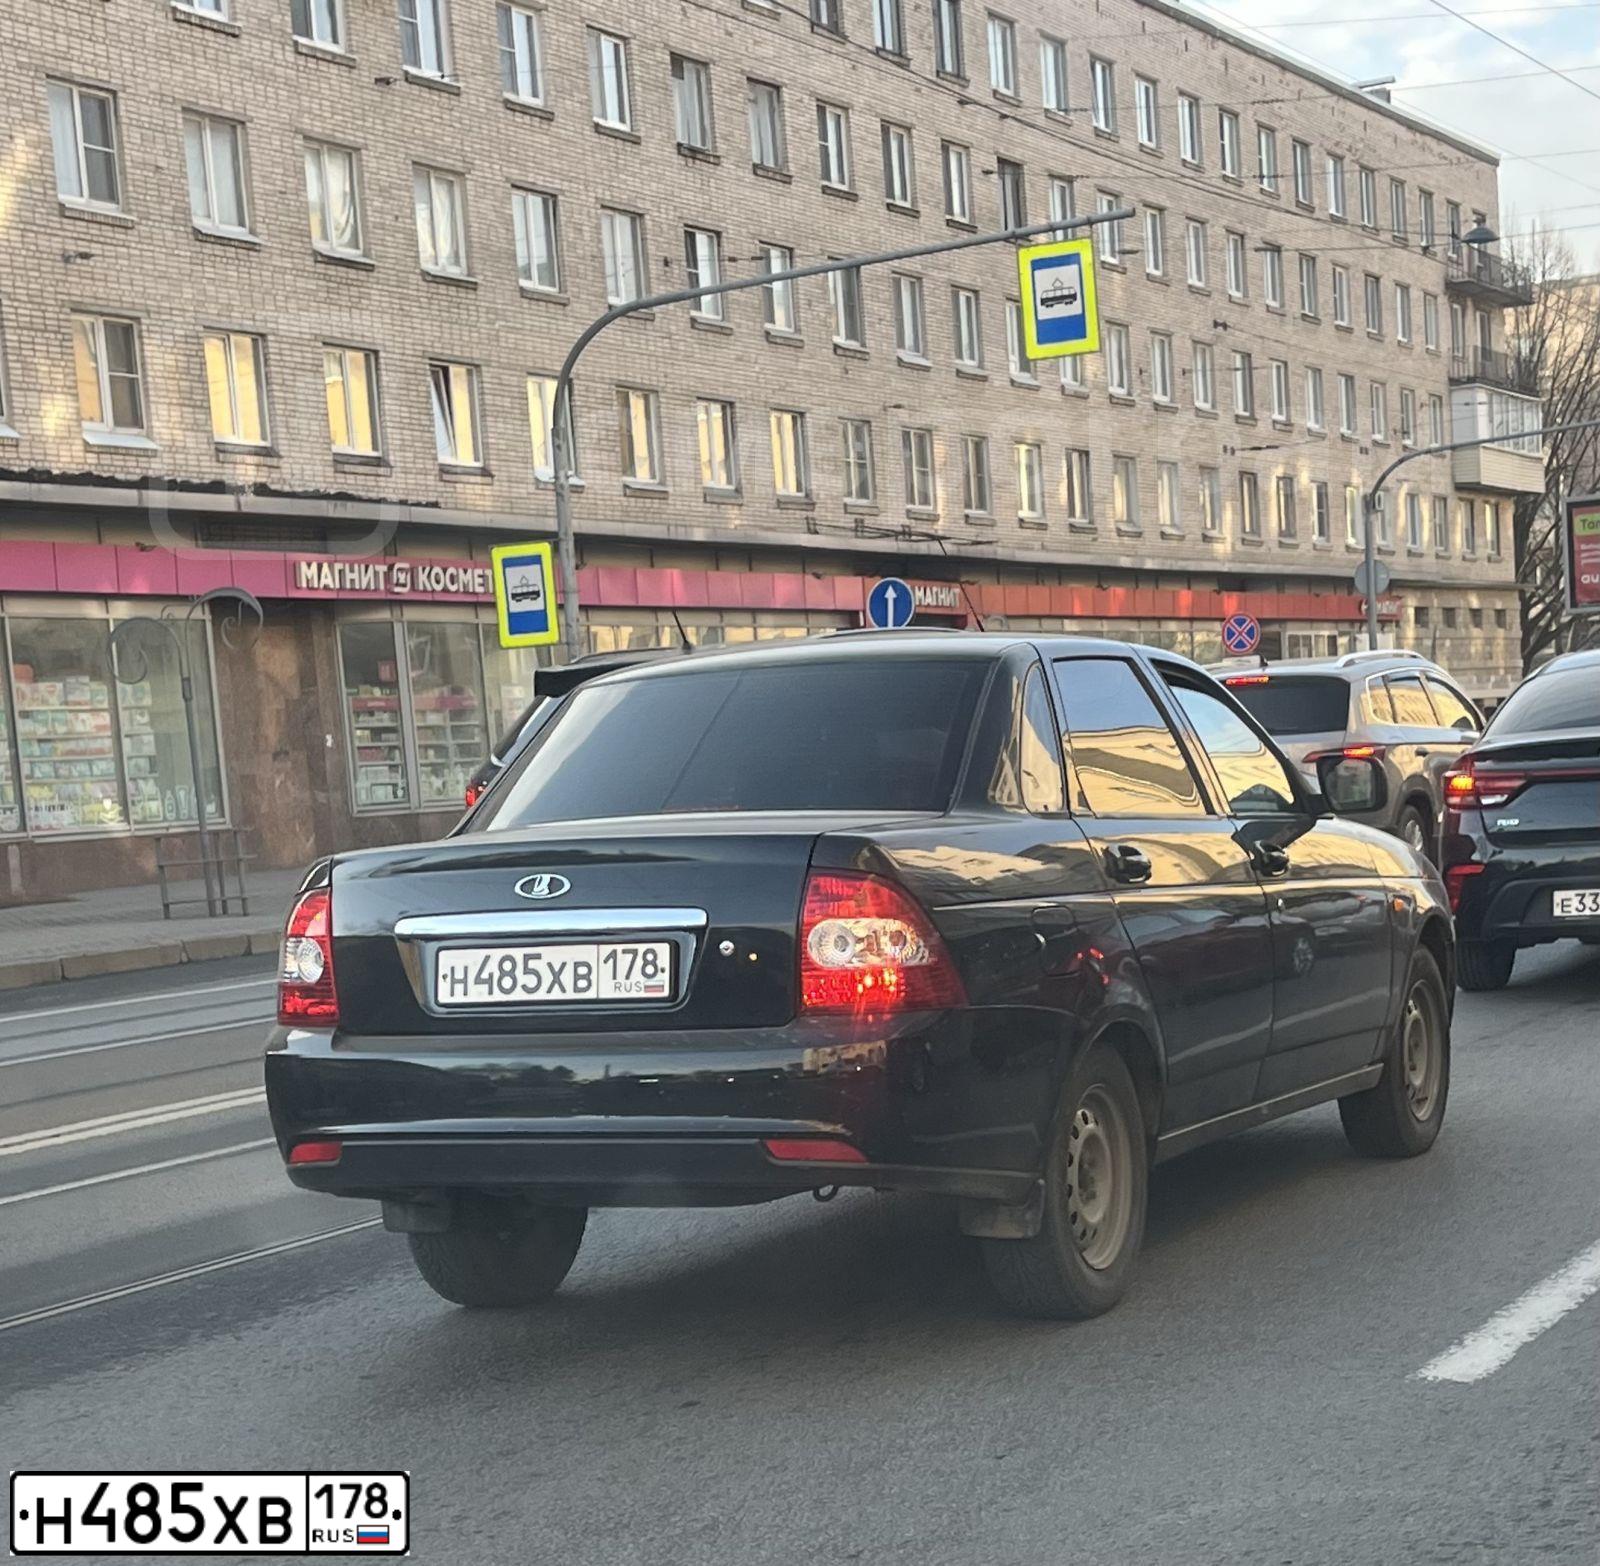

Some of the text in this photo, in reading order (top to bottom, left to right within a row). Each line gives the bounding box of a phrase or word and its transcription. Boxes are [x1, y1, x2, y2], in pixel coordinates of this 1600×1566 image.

[299, 560, 388, 590] МАГНИТ
[914, 585, 960, 607] МАГНИТ
[603, 948, 658, 981] 178
[613, 981, 642, 993] RUS
